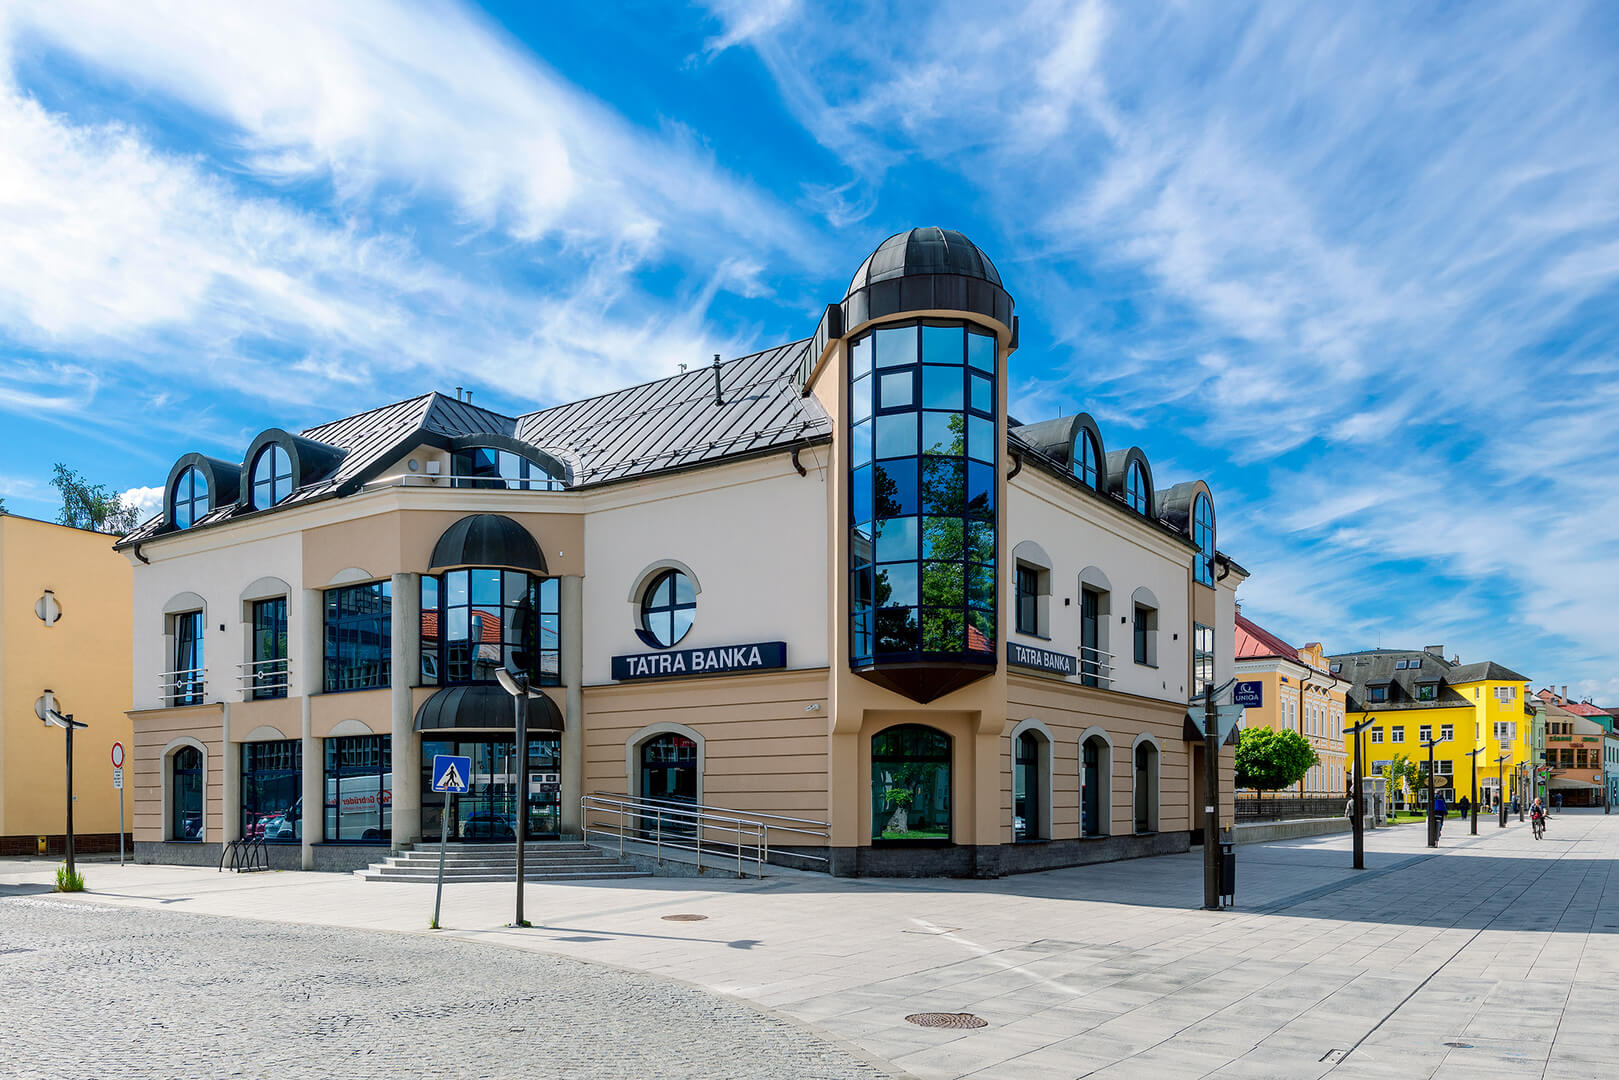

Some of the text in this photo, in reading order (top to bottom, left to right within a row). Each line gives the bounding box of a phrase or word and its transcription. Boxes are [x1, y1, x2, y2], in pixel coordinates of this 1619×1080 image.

[626, 646, 762, 676] TATRA BANKA
[1015, 646, 1070, 672] TATRA BANKA
[1235, 694, 1259, 702] UNIQA
